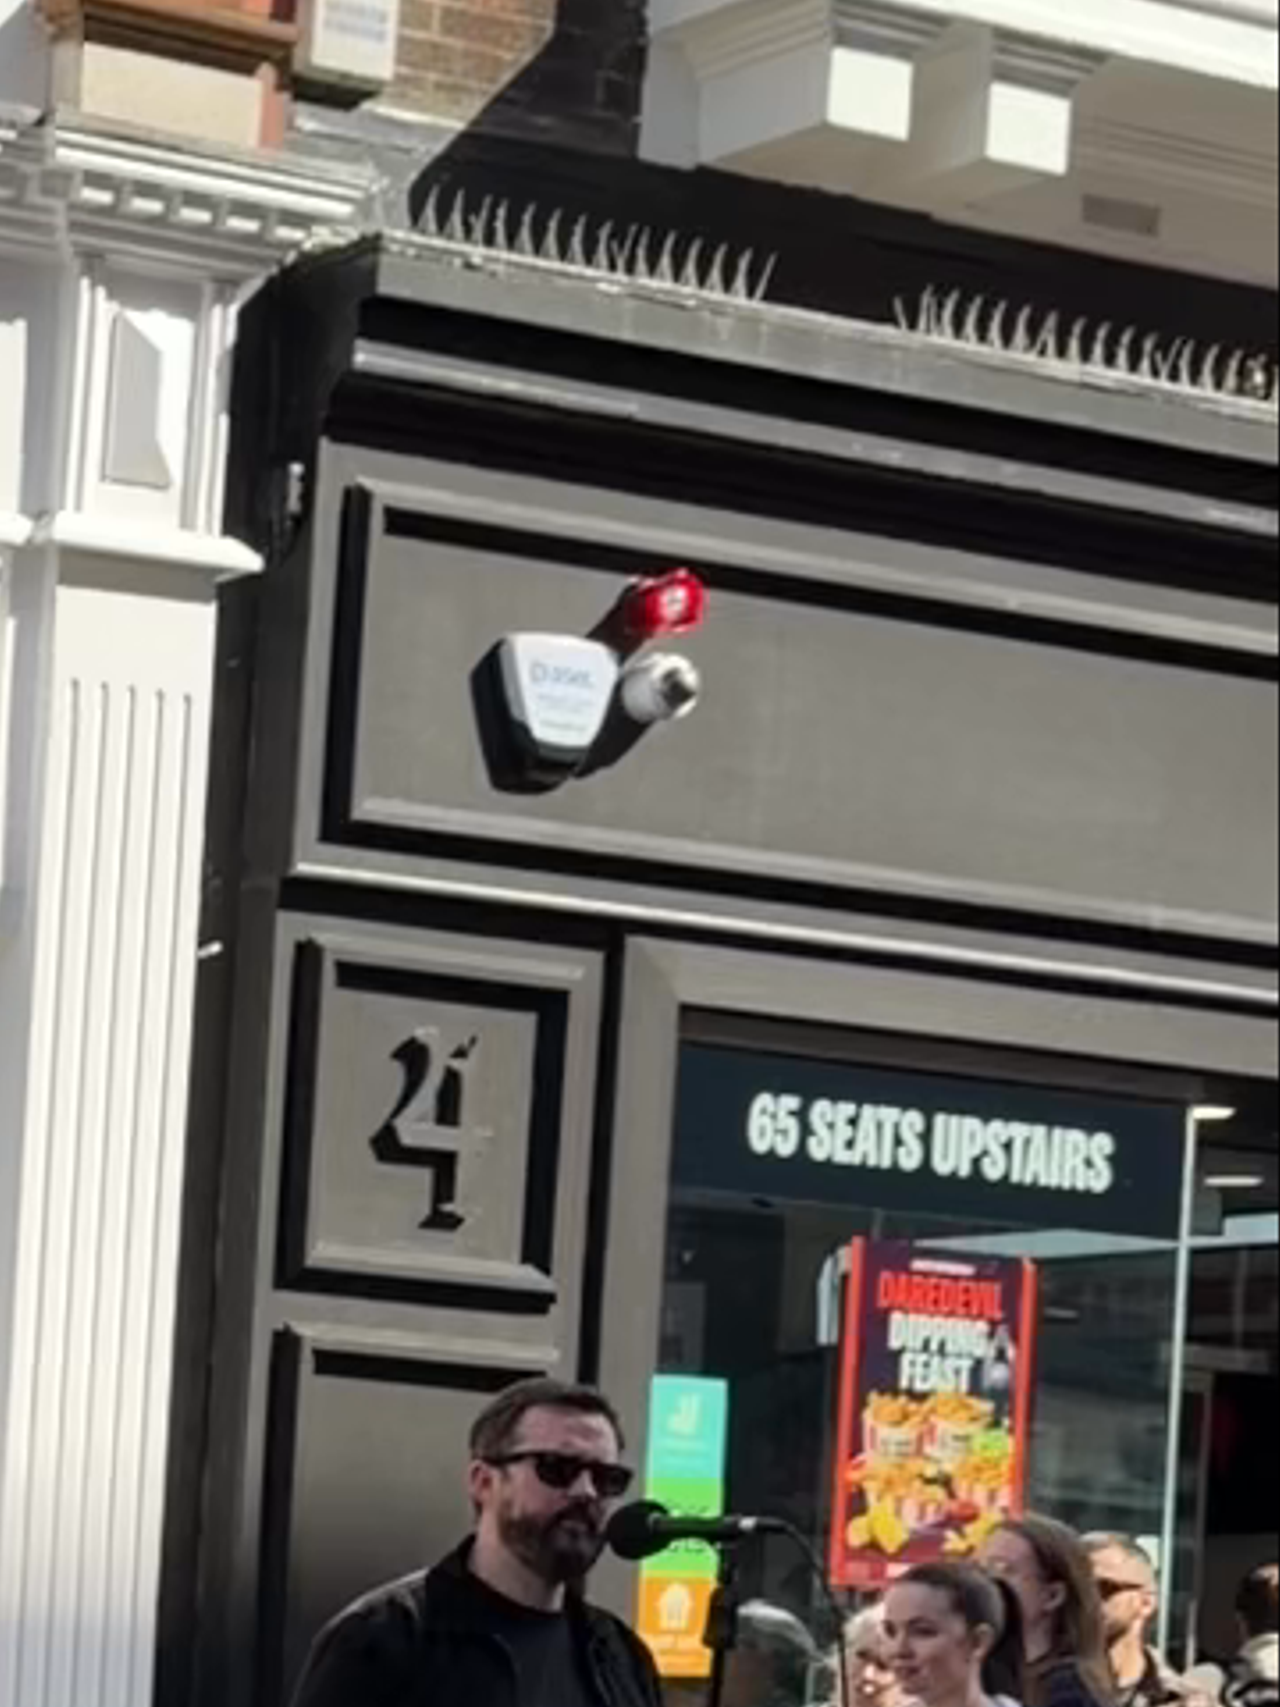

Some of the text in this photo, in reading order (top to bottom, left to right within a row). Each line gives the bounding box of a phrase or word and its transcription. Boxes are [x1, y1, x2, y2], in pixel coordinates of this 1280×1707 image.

[747, 1092, 1114, 1193] 65 SEATS UPSTAIRS
[899, 1352, 974, 1393] FEAST
